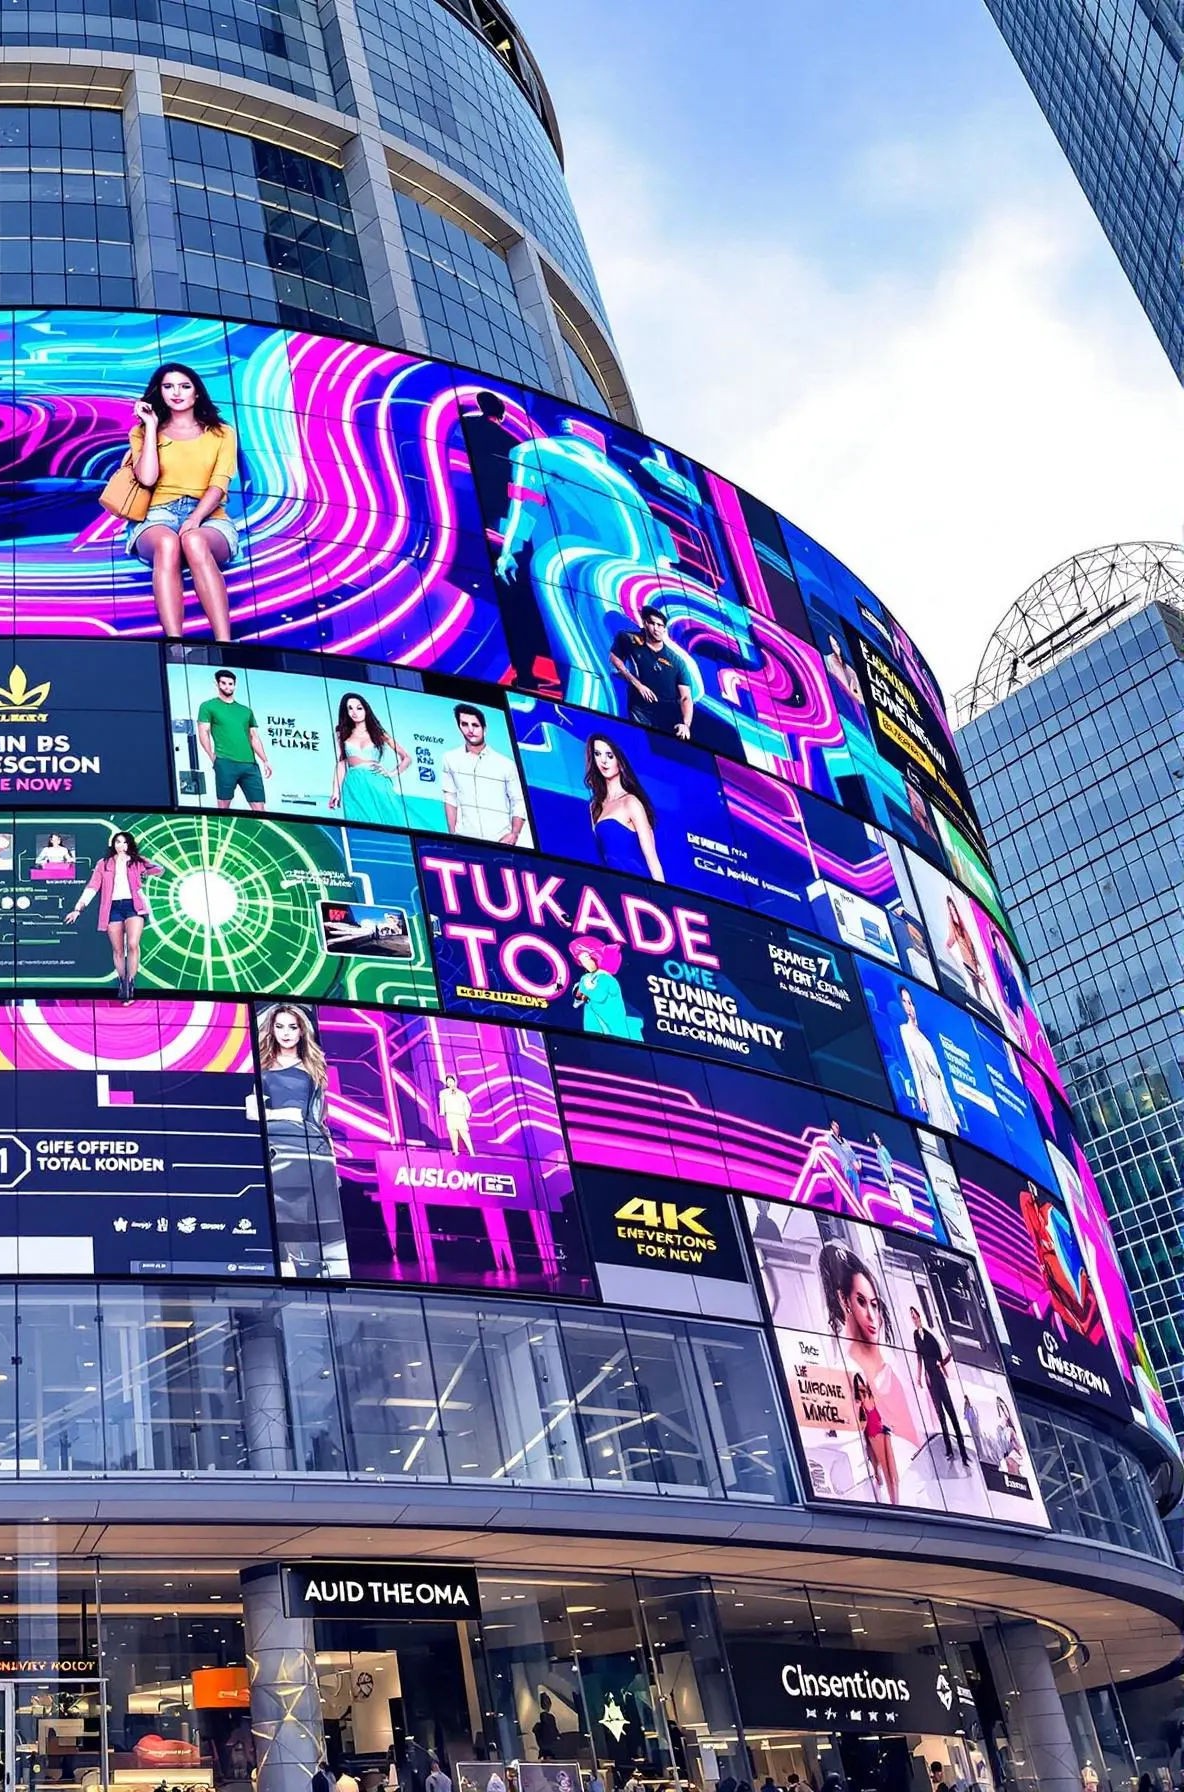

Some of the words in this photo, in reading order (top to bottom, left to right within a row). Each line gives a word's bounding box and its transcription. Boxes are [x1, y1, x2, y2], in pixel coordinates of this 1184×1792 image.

[444, 923, 571, 1001] TO
[36, 1140, 75, 1155] GIFE
[77, 1141, 140, 1155] OFFIED
[36, 1157, 92, 1171] TOTAL
[95, 1157, 165, 1172] KONDEN
[614, 1197, 715, 1237] 4K
[636, 1243, 667, 1259] FOR
[669, 1249, 703, 1264] NEW
[304, 1580, 364, 1602] AUID
